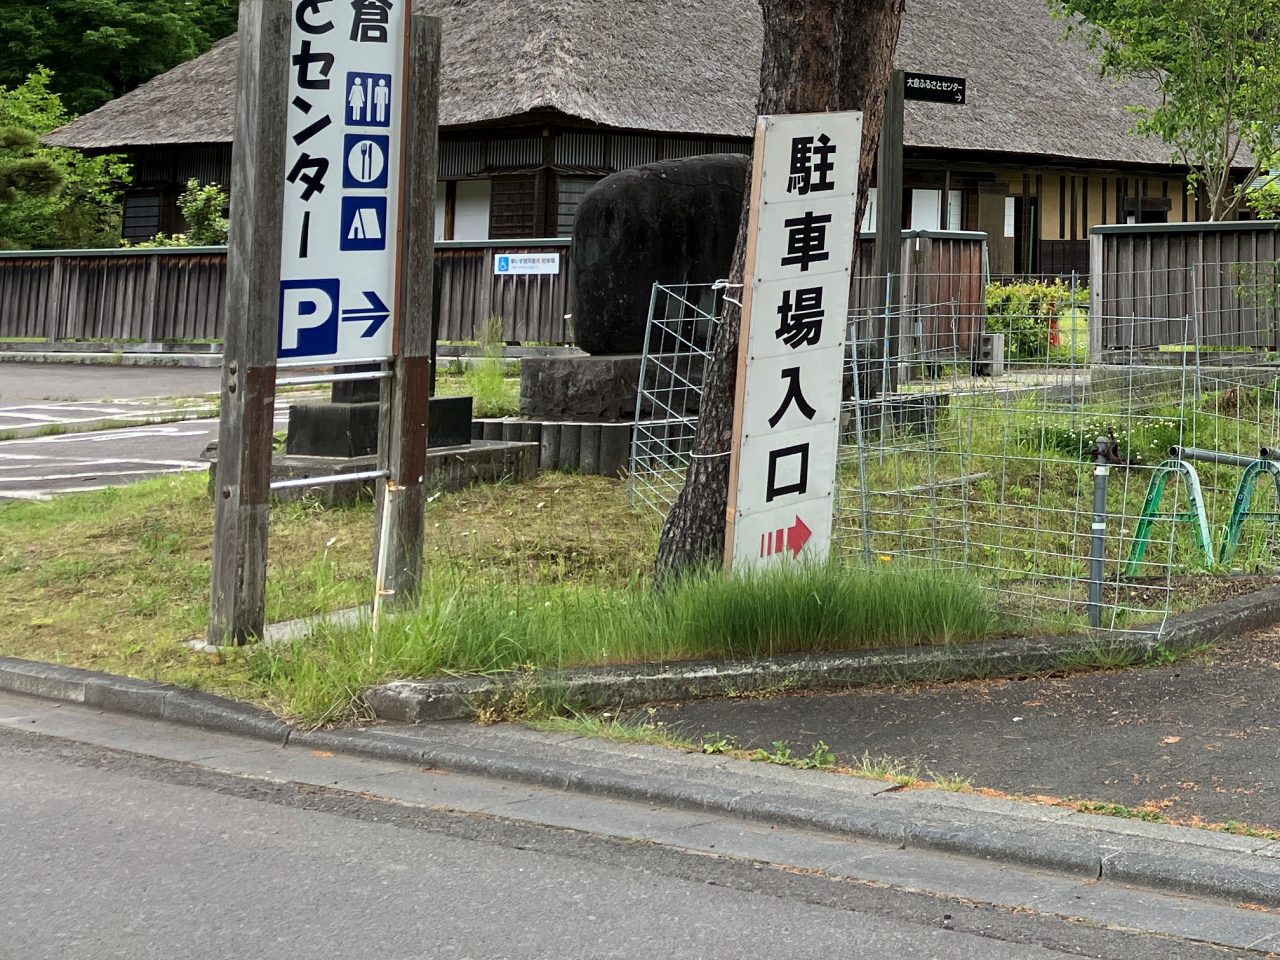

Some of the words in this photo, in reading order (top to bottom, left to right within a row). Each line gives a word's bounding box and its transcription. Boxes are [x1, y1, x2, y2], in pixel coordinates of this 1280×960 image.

[906, 77, 963, 91] 大倉ふるさとセンター
[282, 288, 333, 349] P
[765, 134, 837, 503] 駐車場入口
